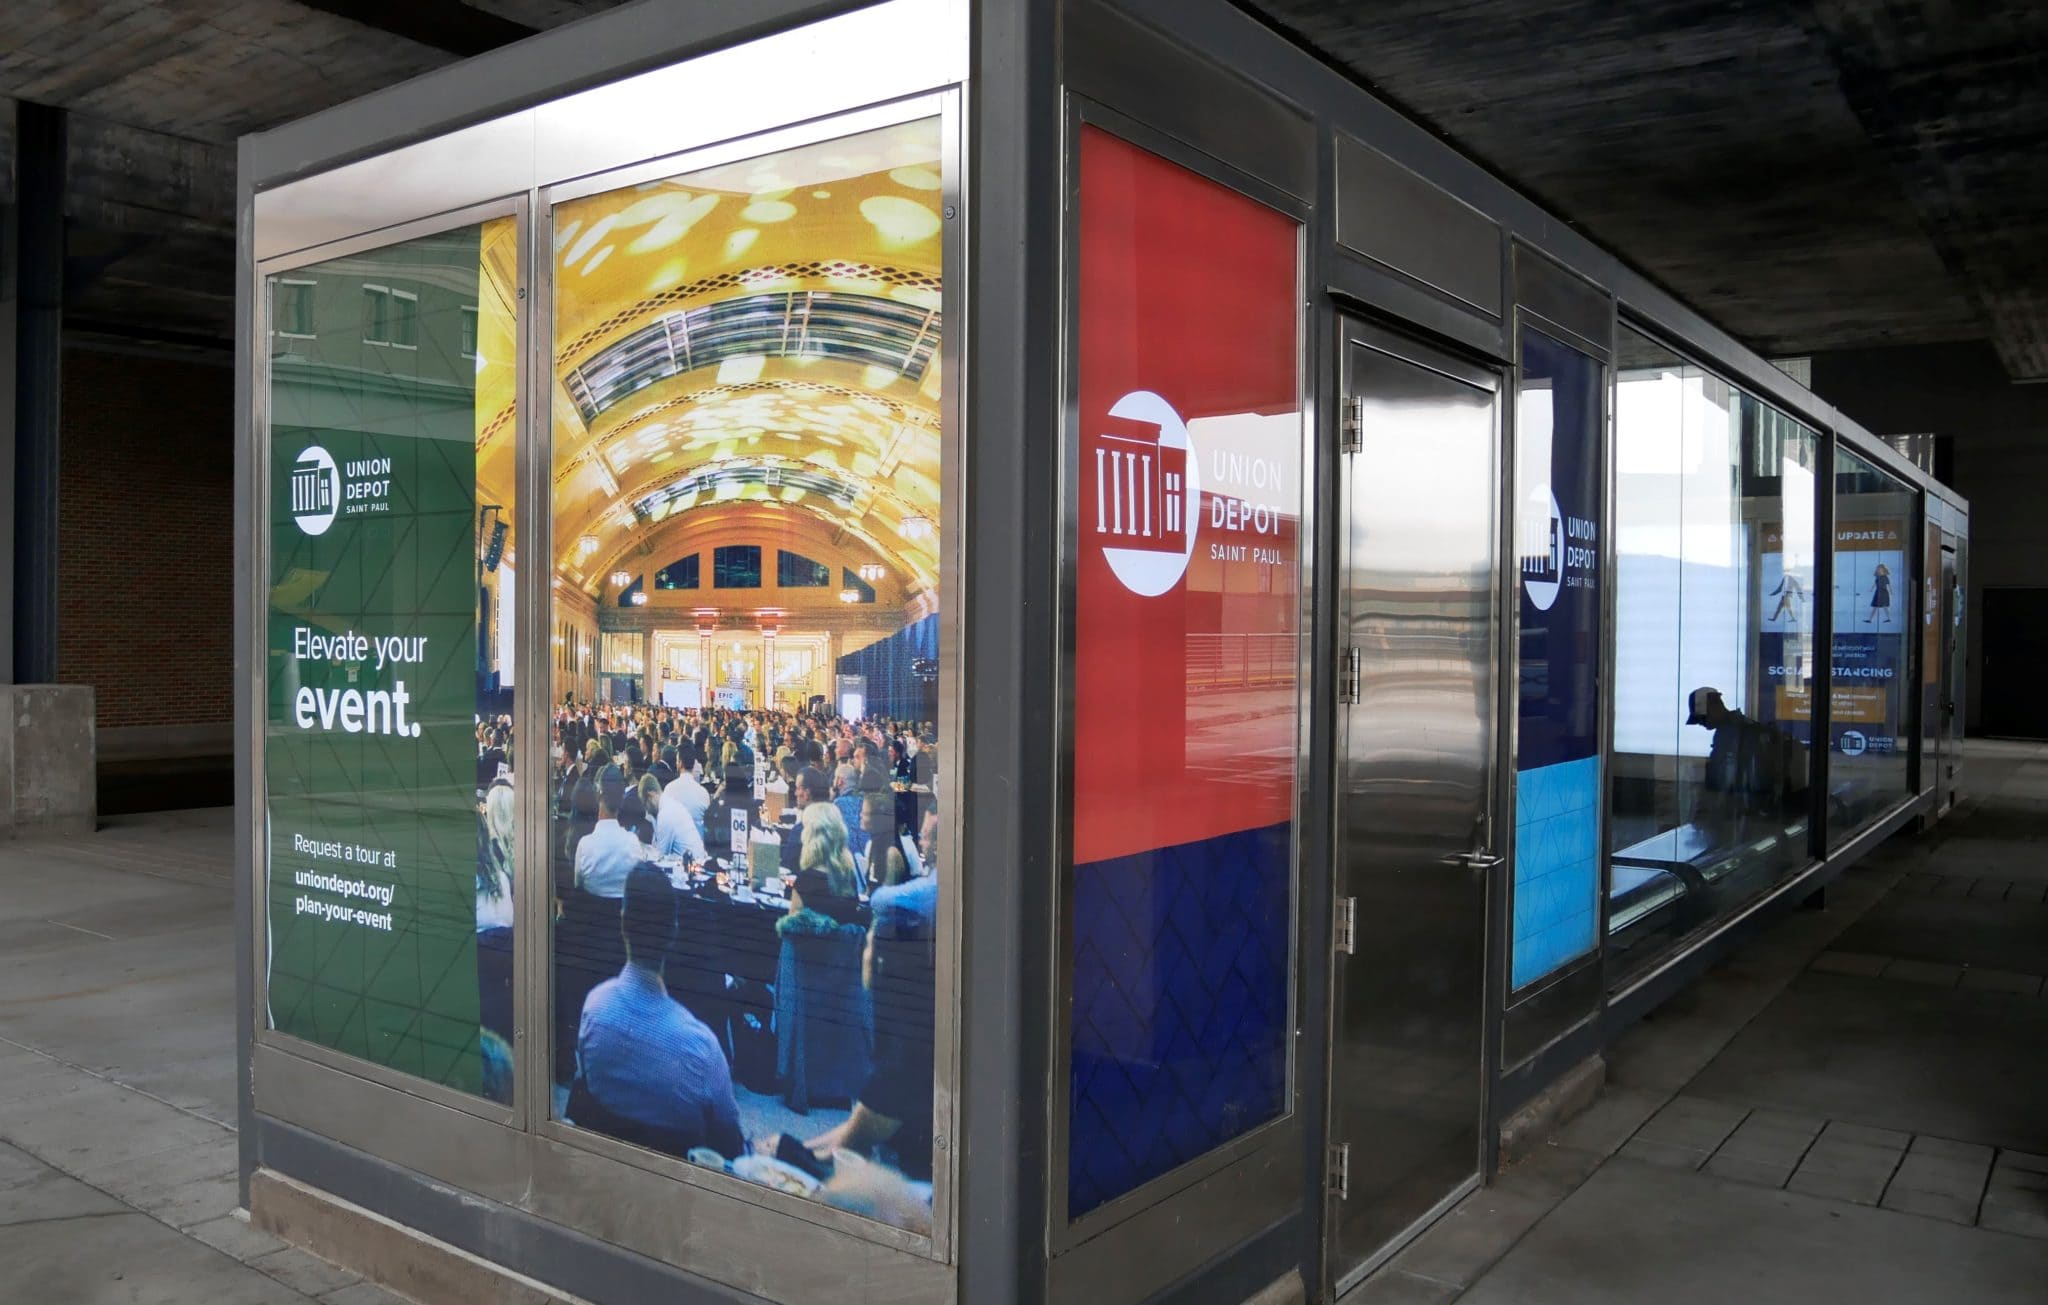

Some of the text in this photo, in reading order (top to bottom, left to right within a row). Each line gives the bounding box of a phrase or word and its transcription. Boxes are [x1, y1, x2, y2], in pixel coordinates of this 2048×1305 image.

[346, 457, 391, 478] UNION
[1213, 449, 1282, 491] UNION
[346, 480, 390, 500] DEPOT
[346, 502, 390, 514] SAINT PAUL
[1211, 496, 1281, 535] DEPOT
[1568, 516, 1596, 541] UNION
[1838, 530, 1885, 540] UPDATE
[1210, 543, 1282, 565] SAINT PAUL
[1567, 546, 1596, 569] DEPOT
[294, 627, 428, 671] Elevate your
[295, 680, 421, 738] event.
[732, 819, 746, 832] 06
[294, 833, 396, 868] Request a tour at
[295, 868, 395, 906] uniondepot.org/
[295, 894, 393, 931] plan-your-event
